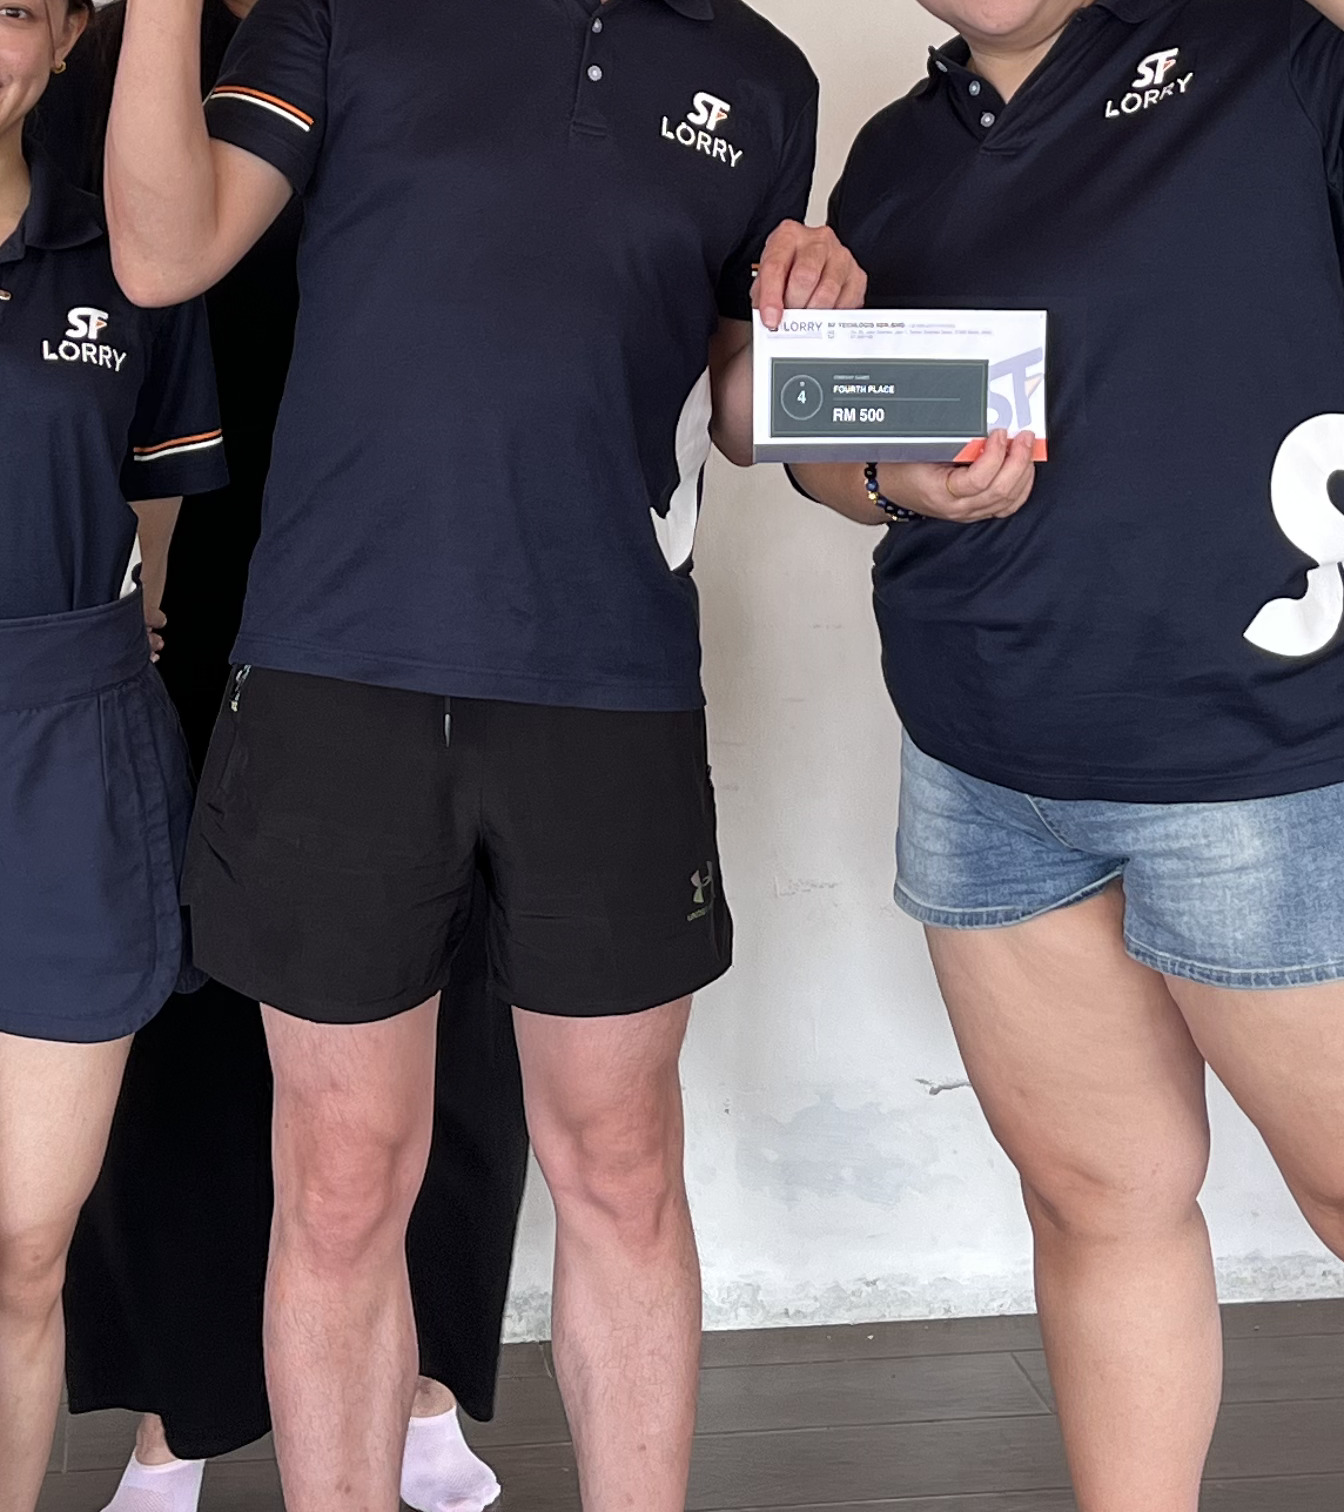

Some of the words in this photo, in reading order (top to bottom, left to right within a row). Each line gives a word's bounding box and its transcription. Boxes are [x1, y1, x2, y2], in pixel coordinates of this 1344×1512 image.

[1105, 72, 1194, 119] LORRY
[661, 115, 743, 168] LORRY
[783, 320, 823, 332] LORRY
[42, 339, 127, 372] LORRY
[797, 390, 807, 404] 4
[833, 384, 867, 394] FOURTH
[867, 384, 895, 394] PLACE
[833, 407, 856, 422] RM
[859, 408, 885, 423] 500
